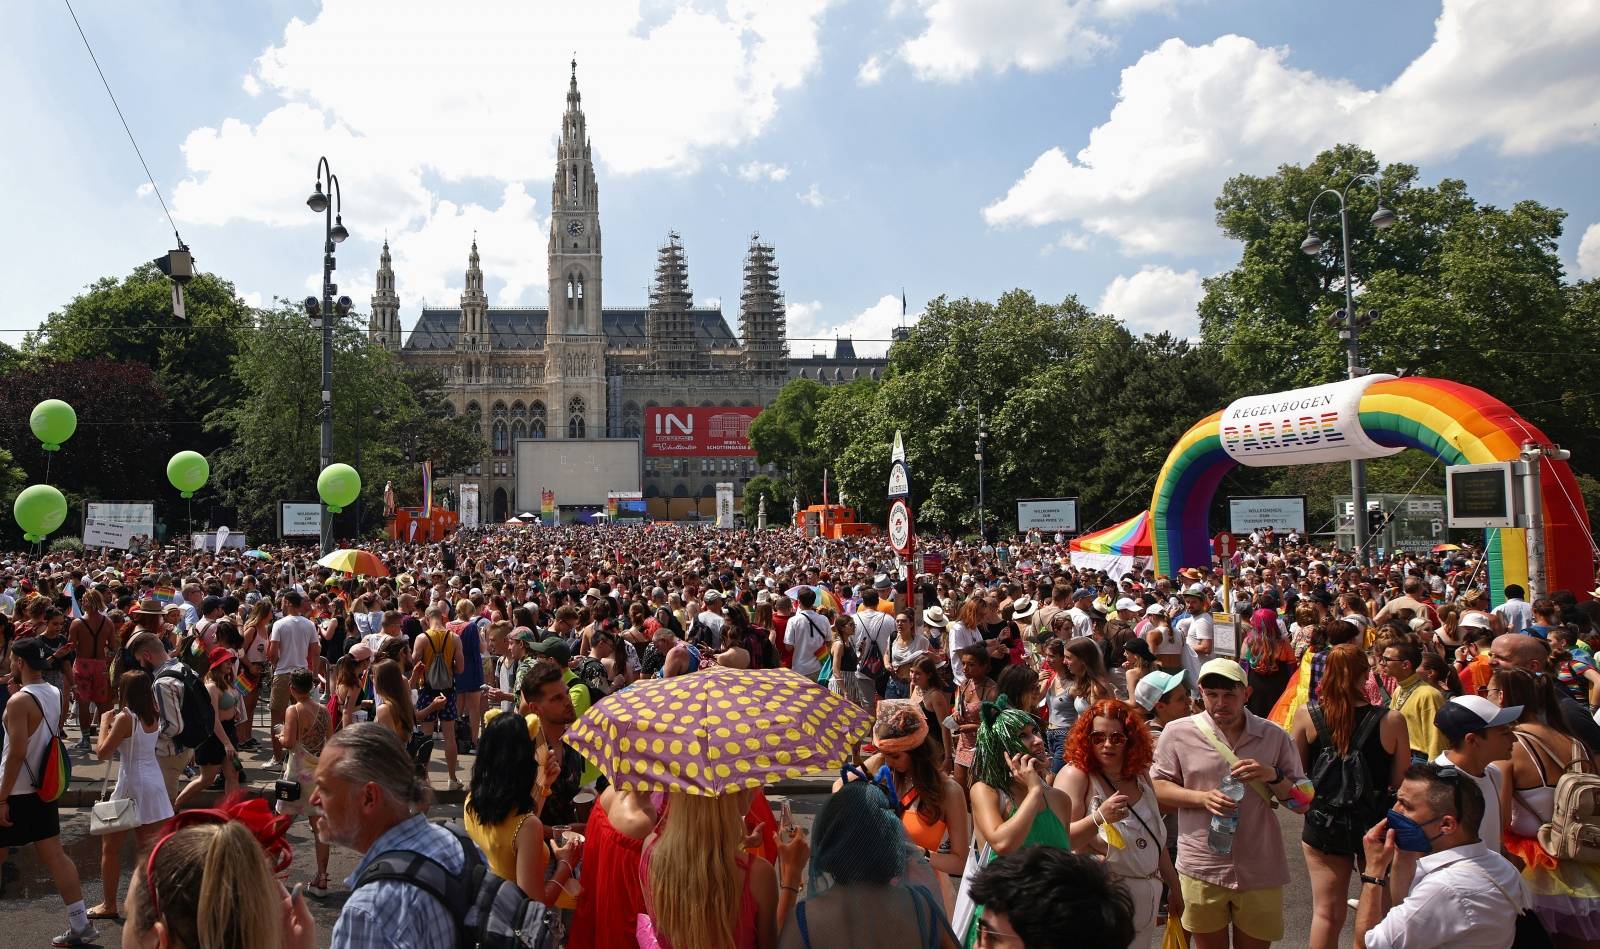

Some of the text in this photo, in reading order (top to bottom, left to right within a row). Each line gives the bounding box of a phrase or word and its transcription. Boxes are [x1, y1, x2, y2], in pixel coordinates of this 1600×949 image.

[1232, 394, 1335, 419] REGENBOGEN
[655, 413, 694, 435] IN
[1224, 411, 1345, 452] PARADE
[1431, 522, 1442, 537] P
